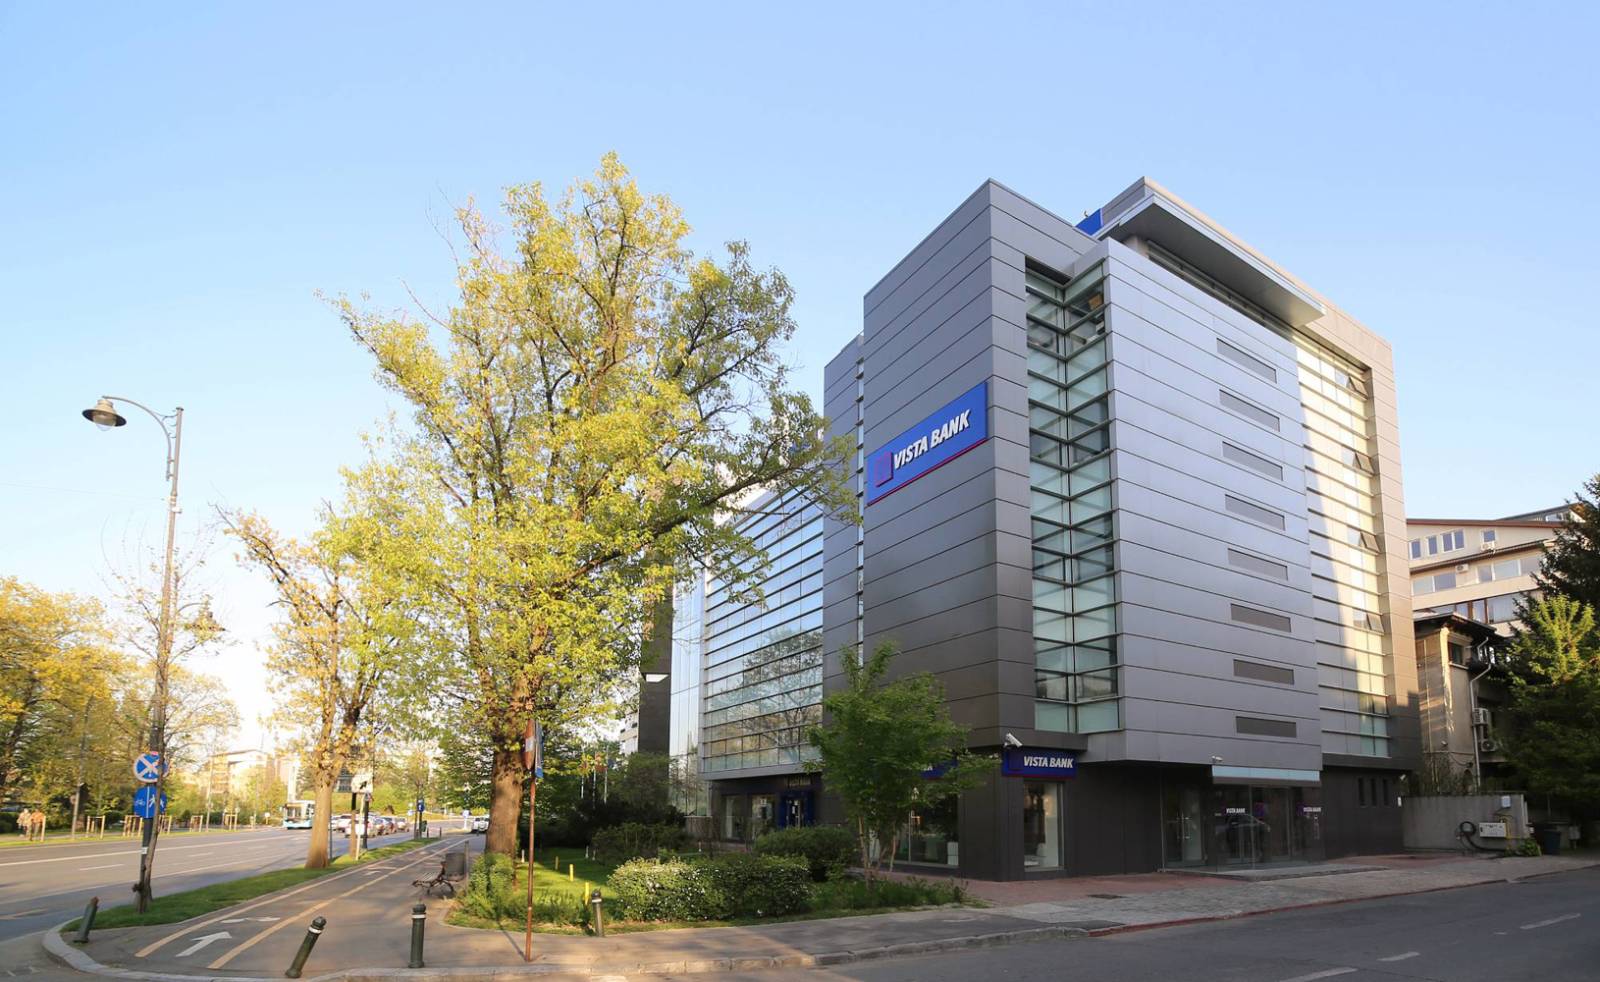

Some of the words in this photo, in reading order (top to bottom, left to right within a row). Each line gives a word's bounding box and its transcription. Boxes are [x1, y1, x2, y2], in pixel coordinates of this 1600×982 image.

[894, 436, 928, 470] VISTA
[931, 409, 970, 448] BANK
[1024, 756, 1048, 767] VISTA
[1049, 757, 1073, 768] BANK
